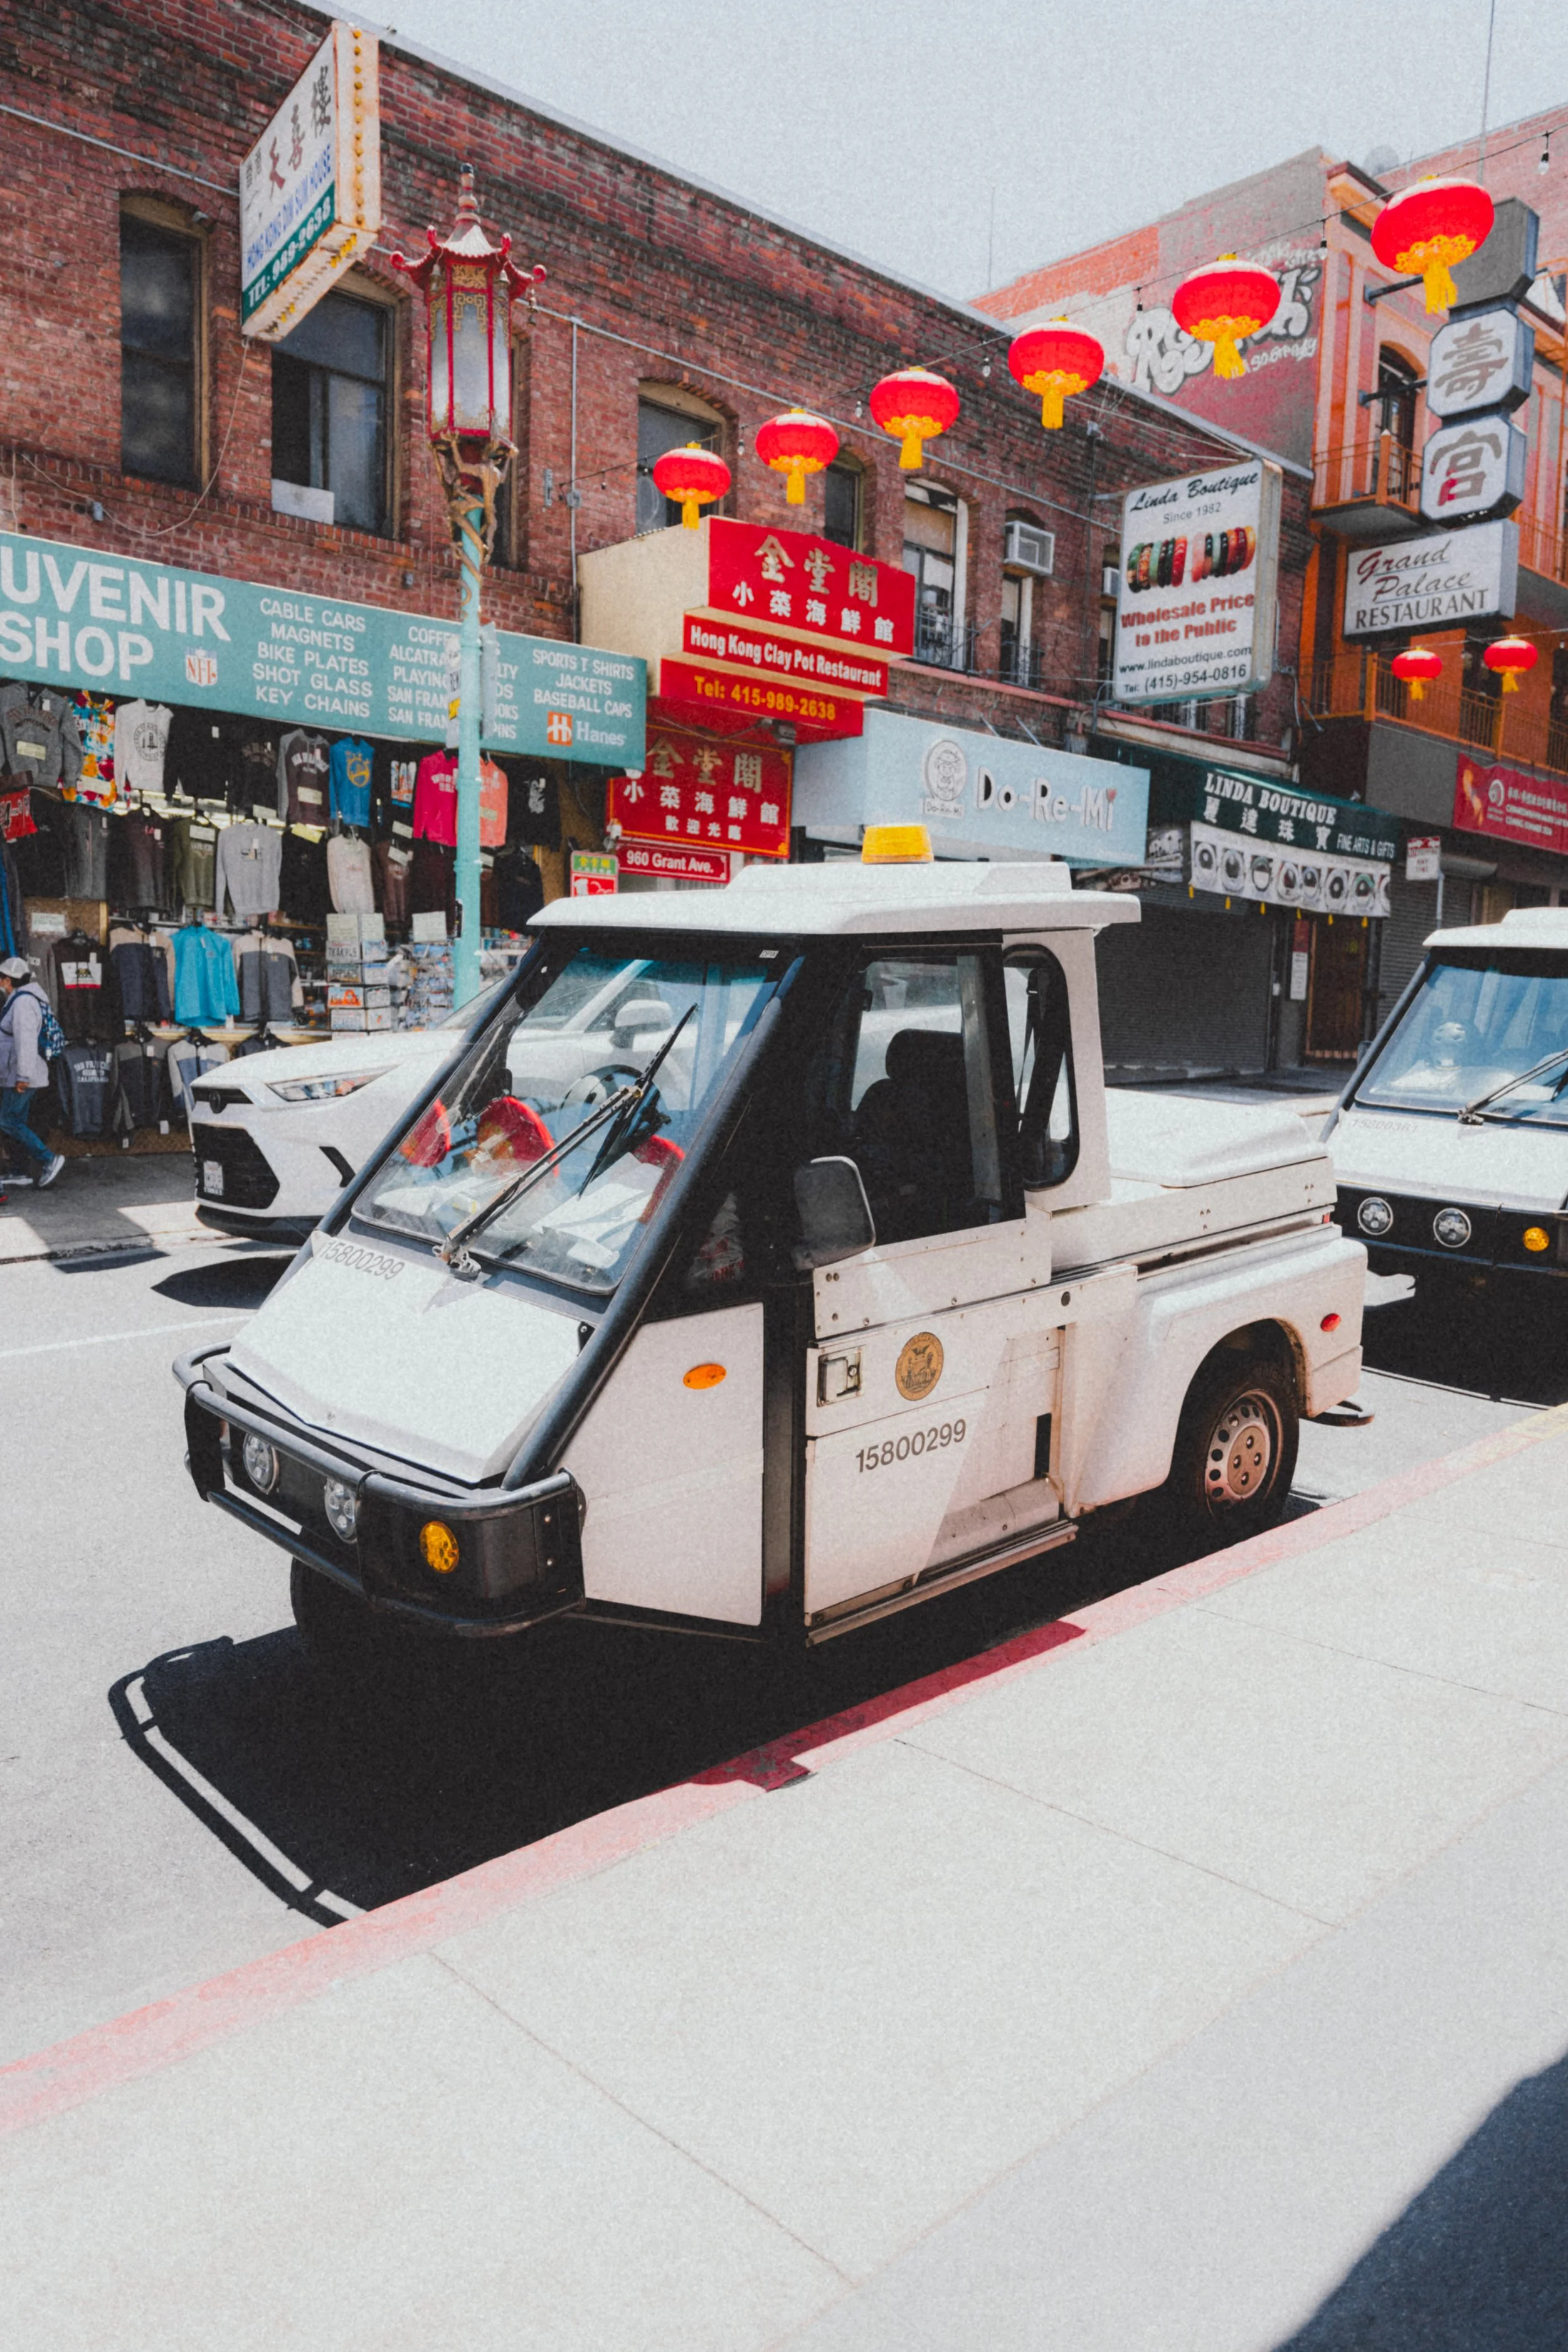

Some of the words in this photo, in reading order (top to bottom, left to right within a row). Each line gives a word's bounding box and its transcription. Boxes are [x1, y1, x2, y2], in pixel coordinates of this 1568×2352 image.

[272, 196, 331, 281] 989-2638
[1130, 488, 1179, 512] Linda
[1187, 471, 1258, 499] Boutique
[1163, 509, 1192, 524] Since
[1196, 501, 1222, 517] 1982
[1357, 540, 1453, 585] Grand
[1373, 569, 1471, 603] Palace
[260, 598, 314, 623] CABLE
[322, 610, 366, 633] CARS
[732, 581, 894, 644] 小菜海鮮館
[1121, 601, 1205, 628] Wholesale
[1210, 593, 1255, 613] Price
[1355, 590, 1489, 629] RESTAURANT
[0, 610, 154, 681] SHOP
[271, 622, 355, 652] MAGNETS
[1135, 632, 1151, 647] to
[1155, 627, 1180, 645] the
[1184, 618, 1237, 640] Public
[188, 656, 217, 684] NFL
[258, 641, 295, 664] BIKE
[304, 650, 369, 677] PLATES
[532, 649, 577, 671] SPORTS
[581, 658, 590, 672] T
[593, 659, 635, 681] SHIRTS
[691, 625, 725, 657] Hong
[728, 635, 761, 665] Kong
[764, 642, 793, 672] Clay
[794, 650, 815, 672] Pot
[817, 655, 882, 687] Restaurant
[1119, 646, 1253, 674] www.lindaboutique.com
[253, 662, 300, 686] SHOT
[310, 672, 373, 698] GLASS
[387, 686, 412, 704] SAN
[555, 673, 613, 696] JACKETS
[1145, 664, 1247, 693] (415)-954-0816
[256, 686, 294, 706] KEY
[304, 693, 371, 718] CHAINS
[534, 688, 601, 714] BASEBALL
[604, 700, 633, 718] CAPS
[694, 675, 726, 699] Tel:
[731, 684, 837, 721] 415-989-2638
[388, 707, 413, 725] SAN
[576, 721, 626, 746] Hanes
[623, 780, 780, 826] 小菜海鮮館
[975, 765, 1118, 833] Do-Re-Mi
[1204, 772, 1254, 805] LINDA
[1258, 789, 1337, 826] BOUTIQUE
[626, 850, 649, 867] 960
[652, 853, 687, 871] Grant
[687, 857, 715, 874] Ave.
[1337, 833, 1353, 852] FINE
[1352, 836, 1370, 855] ARTS
[1377, 840, 1396, 859] GIFTS
[320, 1239, 406, 1281] 15800299
[855, 1418, 967, 1474] 15800299
